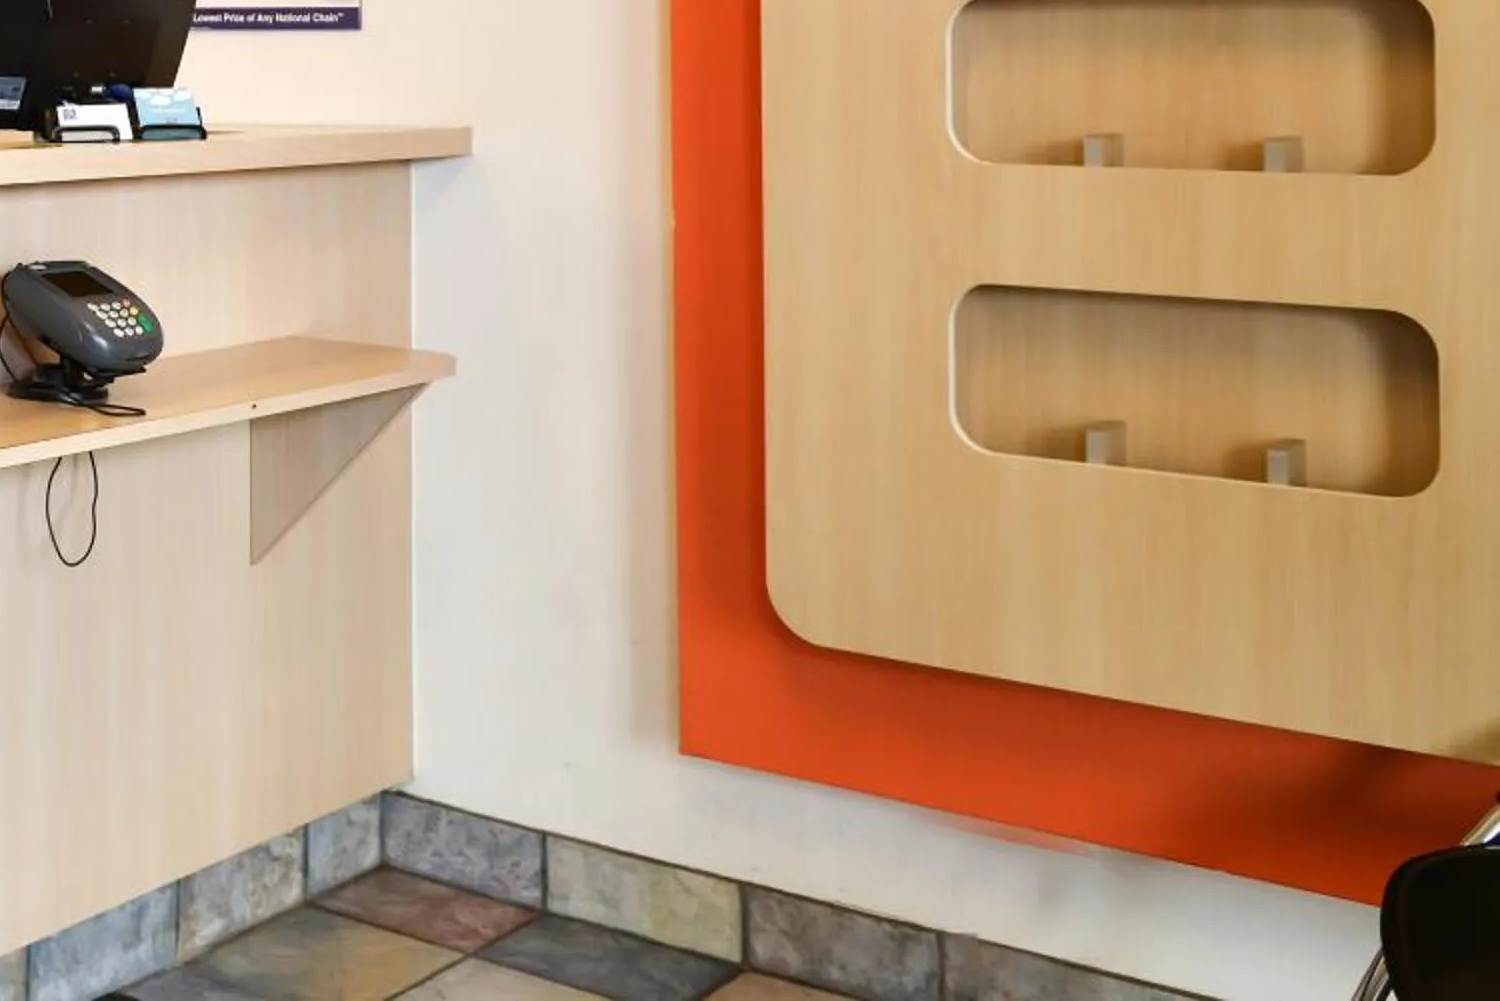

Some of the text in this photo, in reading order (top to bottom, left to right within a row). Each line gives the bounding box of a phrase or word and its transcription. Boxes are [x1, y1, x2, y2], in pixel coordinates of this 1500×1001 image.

[224, 13, 244, 23] Price
[246, 13, 255, 23] of
[257, 13, 273, 24] Any
[275, 12, 311, 23] National
